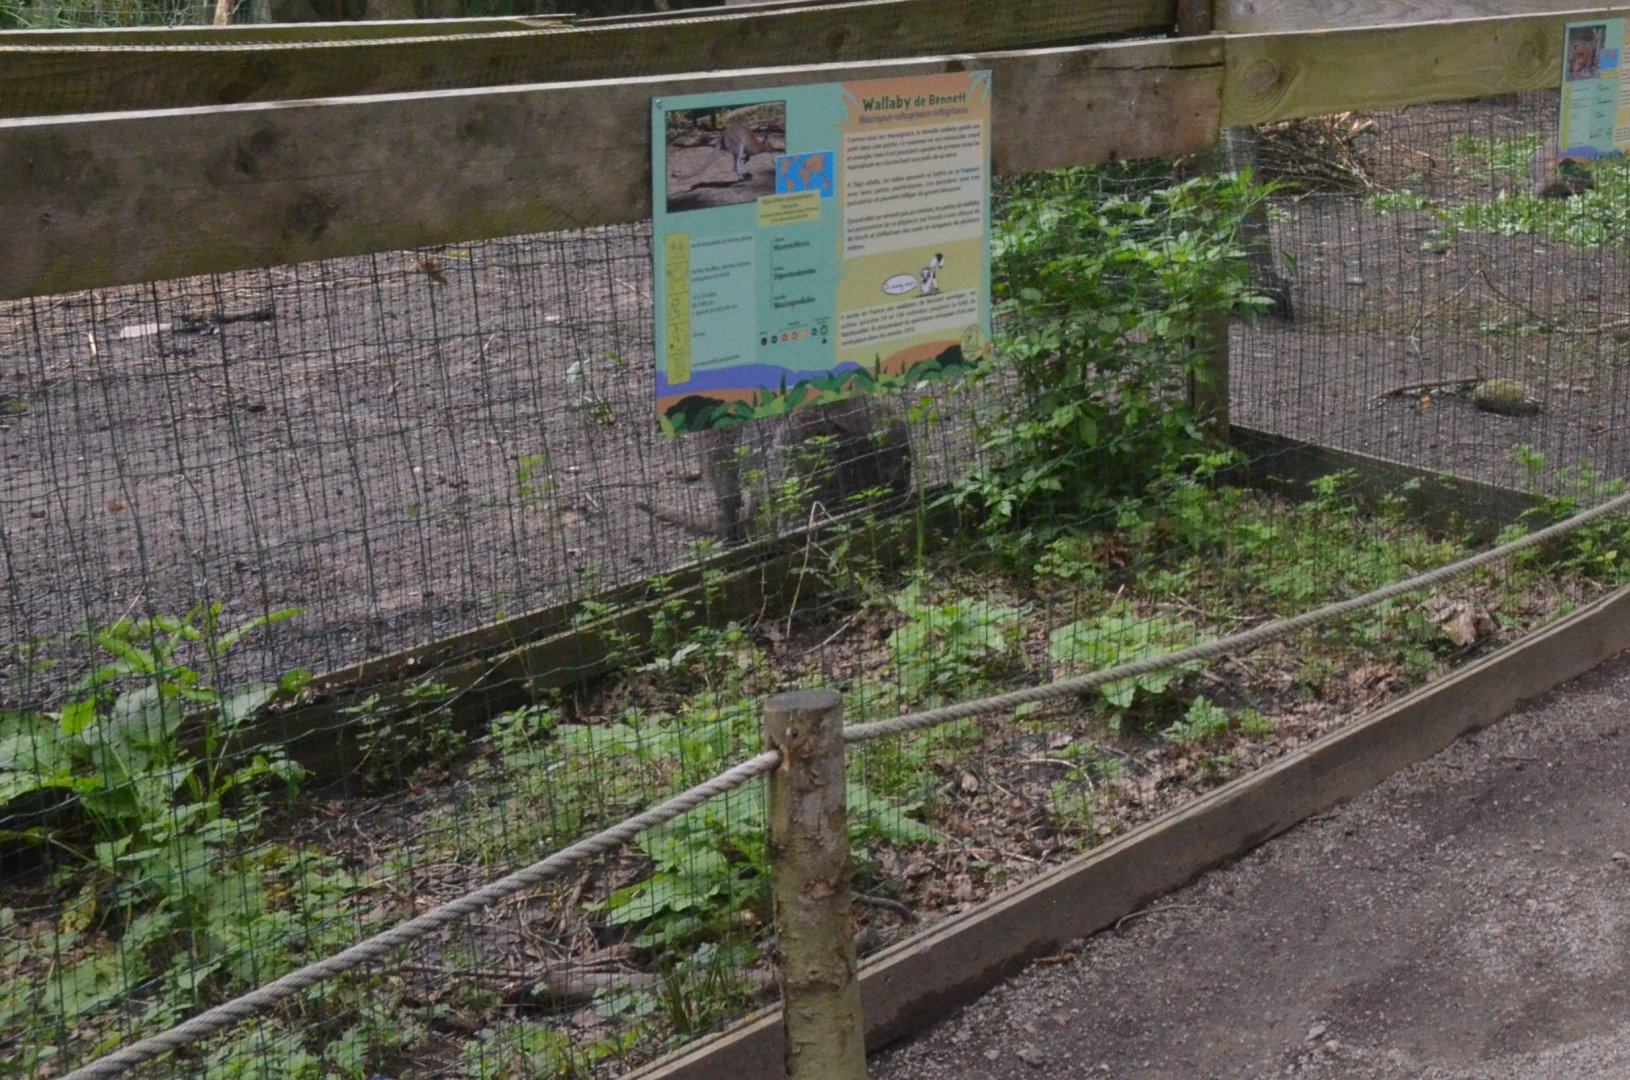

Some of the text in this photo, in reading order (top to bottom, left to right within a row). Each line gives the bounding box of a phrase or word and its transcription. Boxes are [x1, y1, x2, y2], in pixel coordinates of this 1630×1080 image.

[863, 92, 966, 111] Wallaby de Bennett
